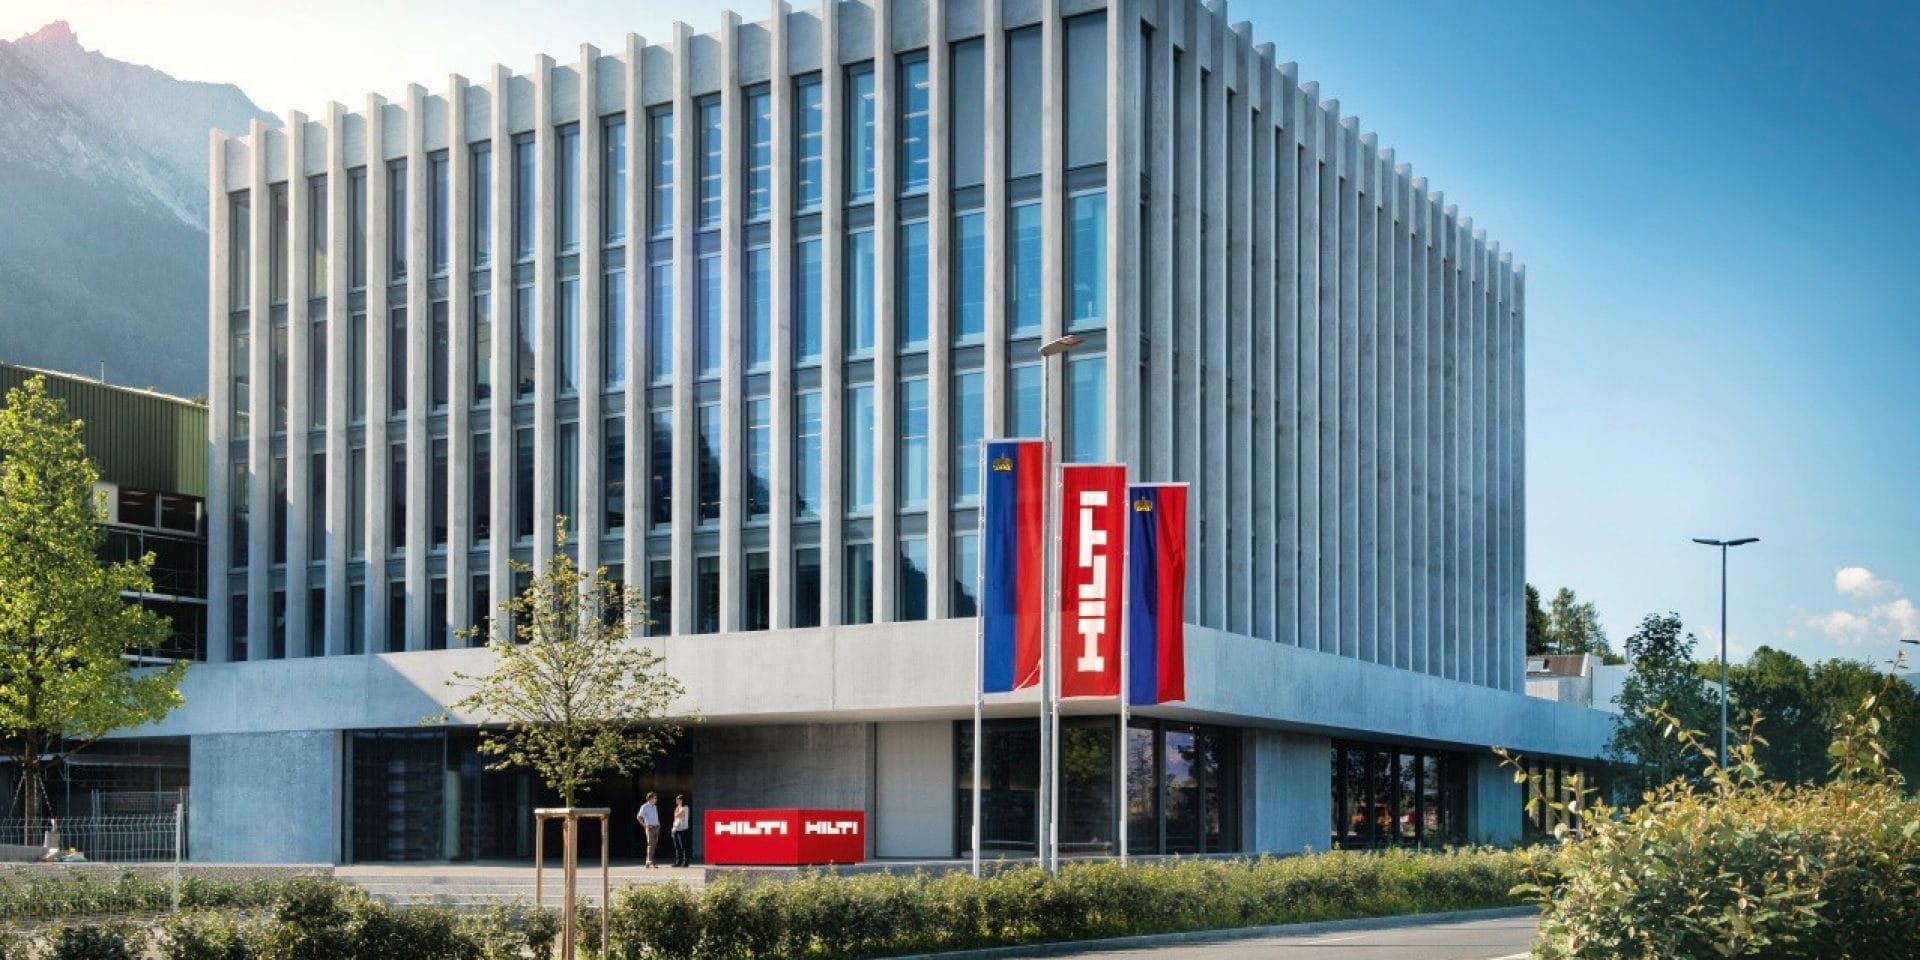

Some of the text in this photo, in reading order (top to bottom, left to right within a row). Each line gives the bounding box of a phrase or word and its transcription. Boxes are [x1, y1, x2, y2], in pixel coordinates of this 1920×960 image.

[1077, 491, 1108, 672] HILTI
[714, 821, 788, 835] HILTI
[804, 821, 858, 835] HILTI
